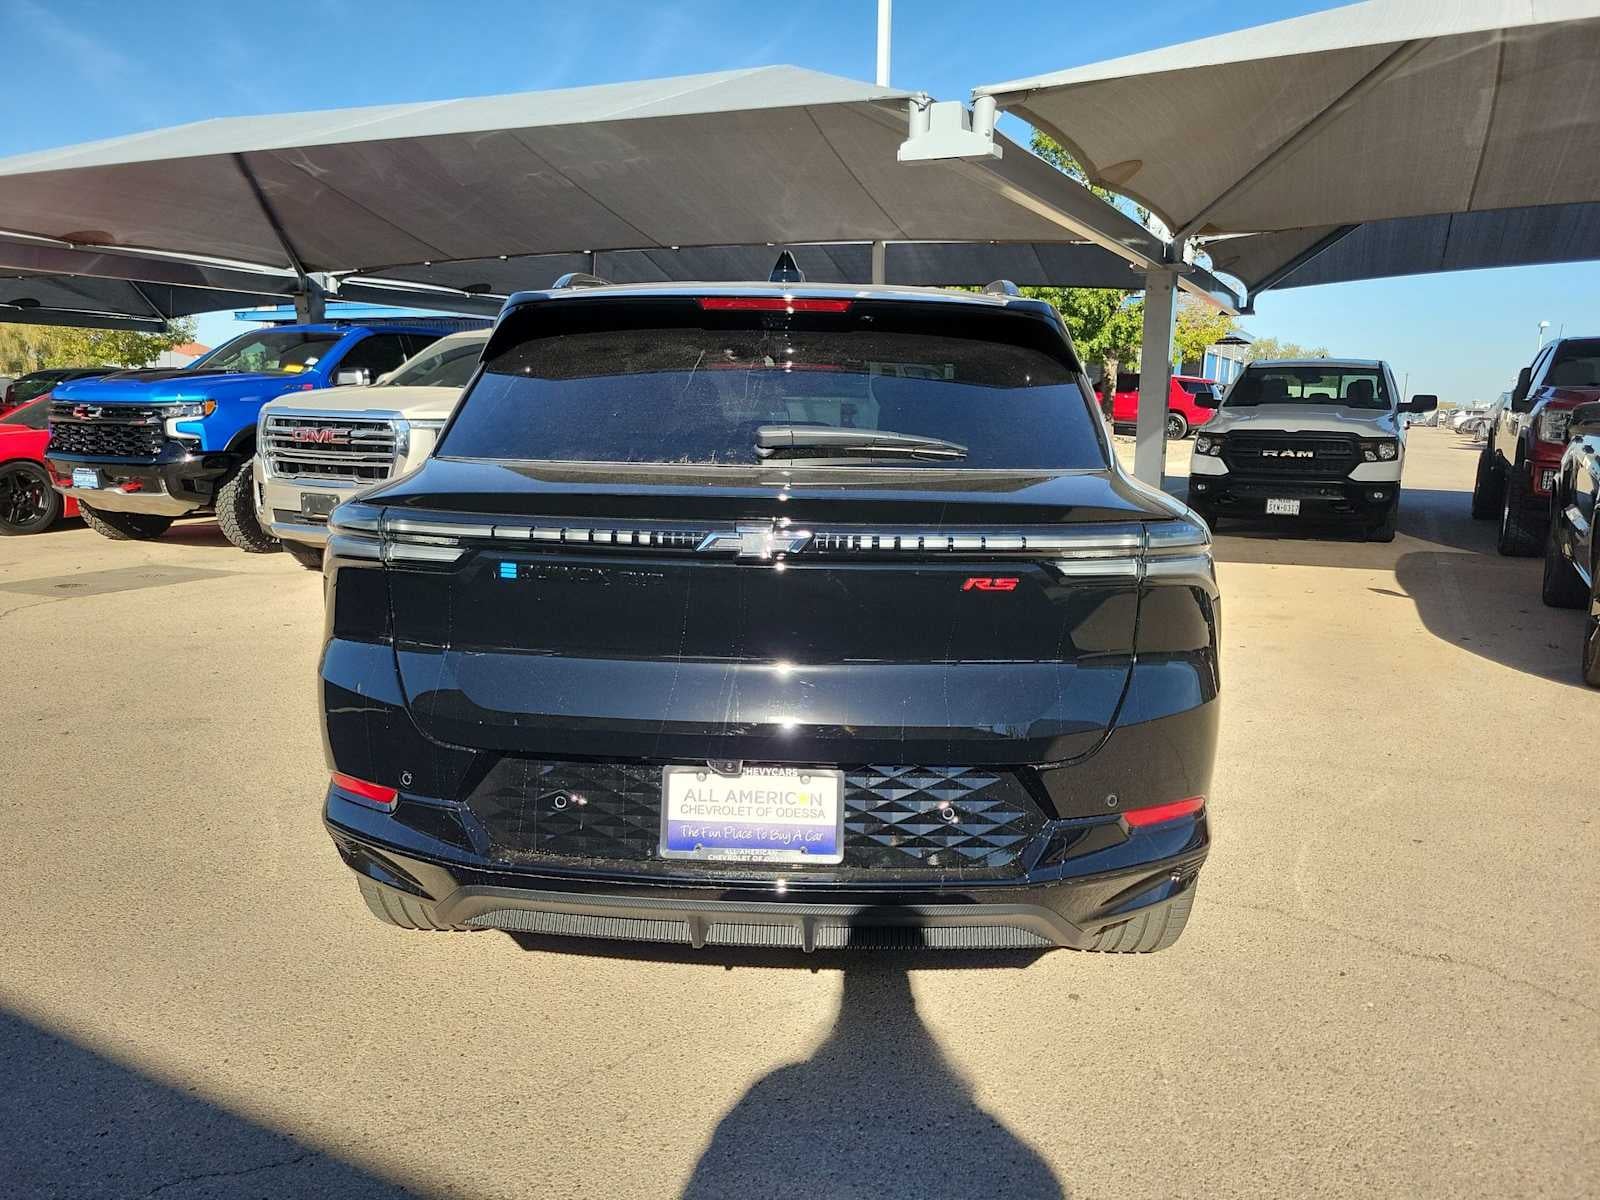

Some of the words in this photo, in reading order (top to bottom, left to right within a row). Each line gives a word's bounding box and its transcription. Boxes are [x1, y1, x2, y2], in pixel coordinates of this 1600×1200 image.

[291, 427, 352, 444] GMC
[1262, 449, 1314, 458] RAM
[961, 577, 1019, 592] RS
[683, 788, 719, 803] ALL
[725, 789, 823, 807] AMERICN
[680, 803, 751, 817] CHEVROLET
[756, 806, 772, 817] OF
[775, 806, 827, 820] ODESSA
[680, 824, 699, 839] The
[701, 826, 722, 839] Fun
[724, 825, 751, 840] Place
[756, 827, 767, 840] To
[770, 829, 791, 845] Buy
[792, 830, 802, 842] A
[805, 830, 824, 842] Car
